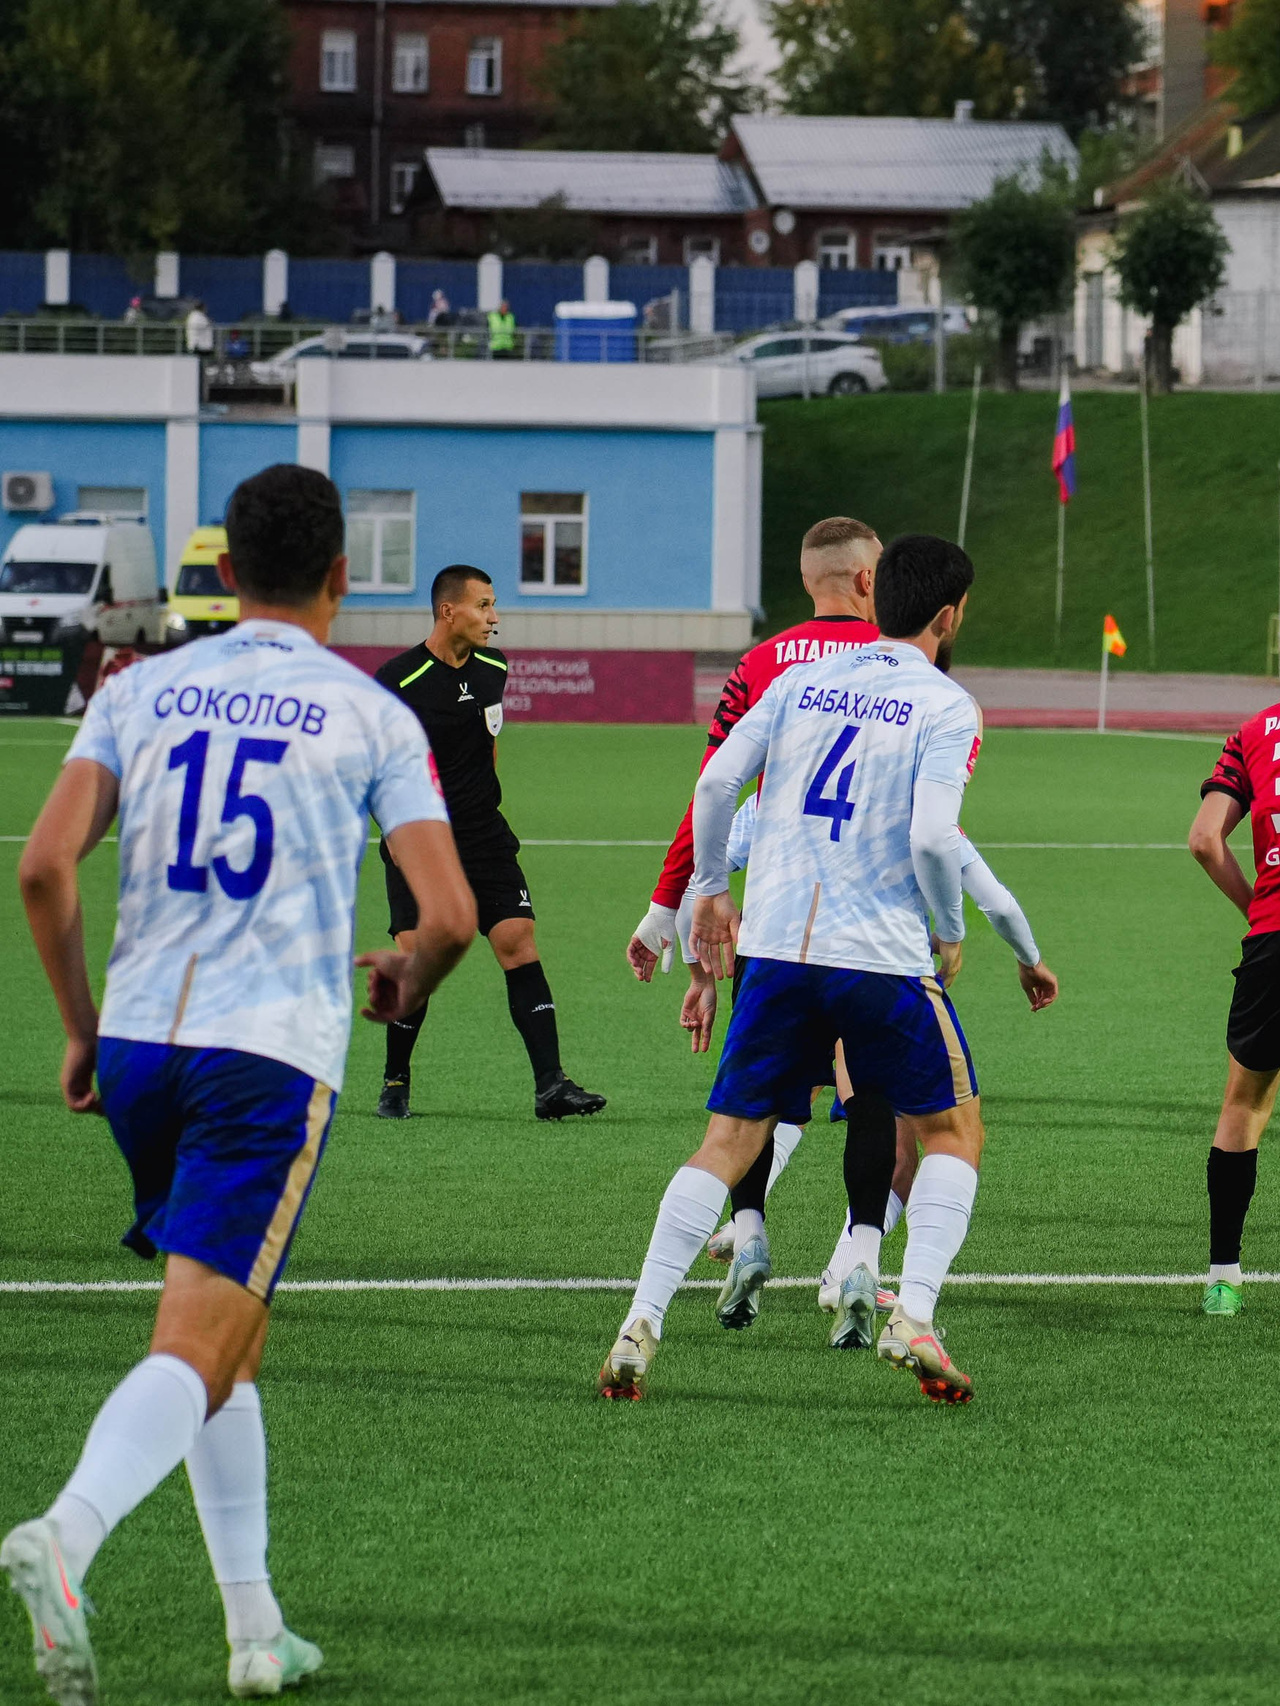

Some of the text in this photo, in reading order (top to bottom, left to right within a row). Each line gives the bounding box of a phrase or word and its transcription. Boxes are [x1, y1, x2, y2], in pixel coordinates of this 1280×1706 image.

[154, 685, 327, 736] СОКОЛОВ
[167, 730, 291, 901] 15
[803, 724, 861, 842] 4
